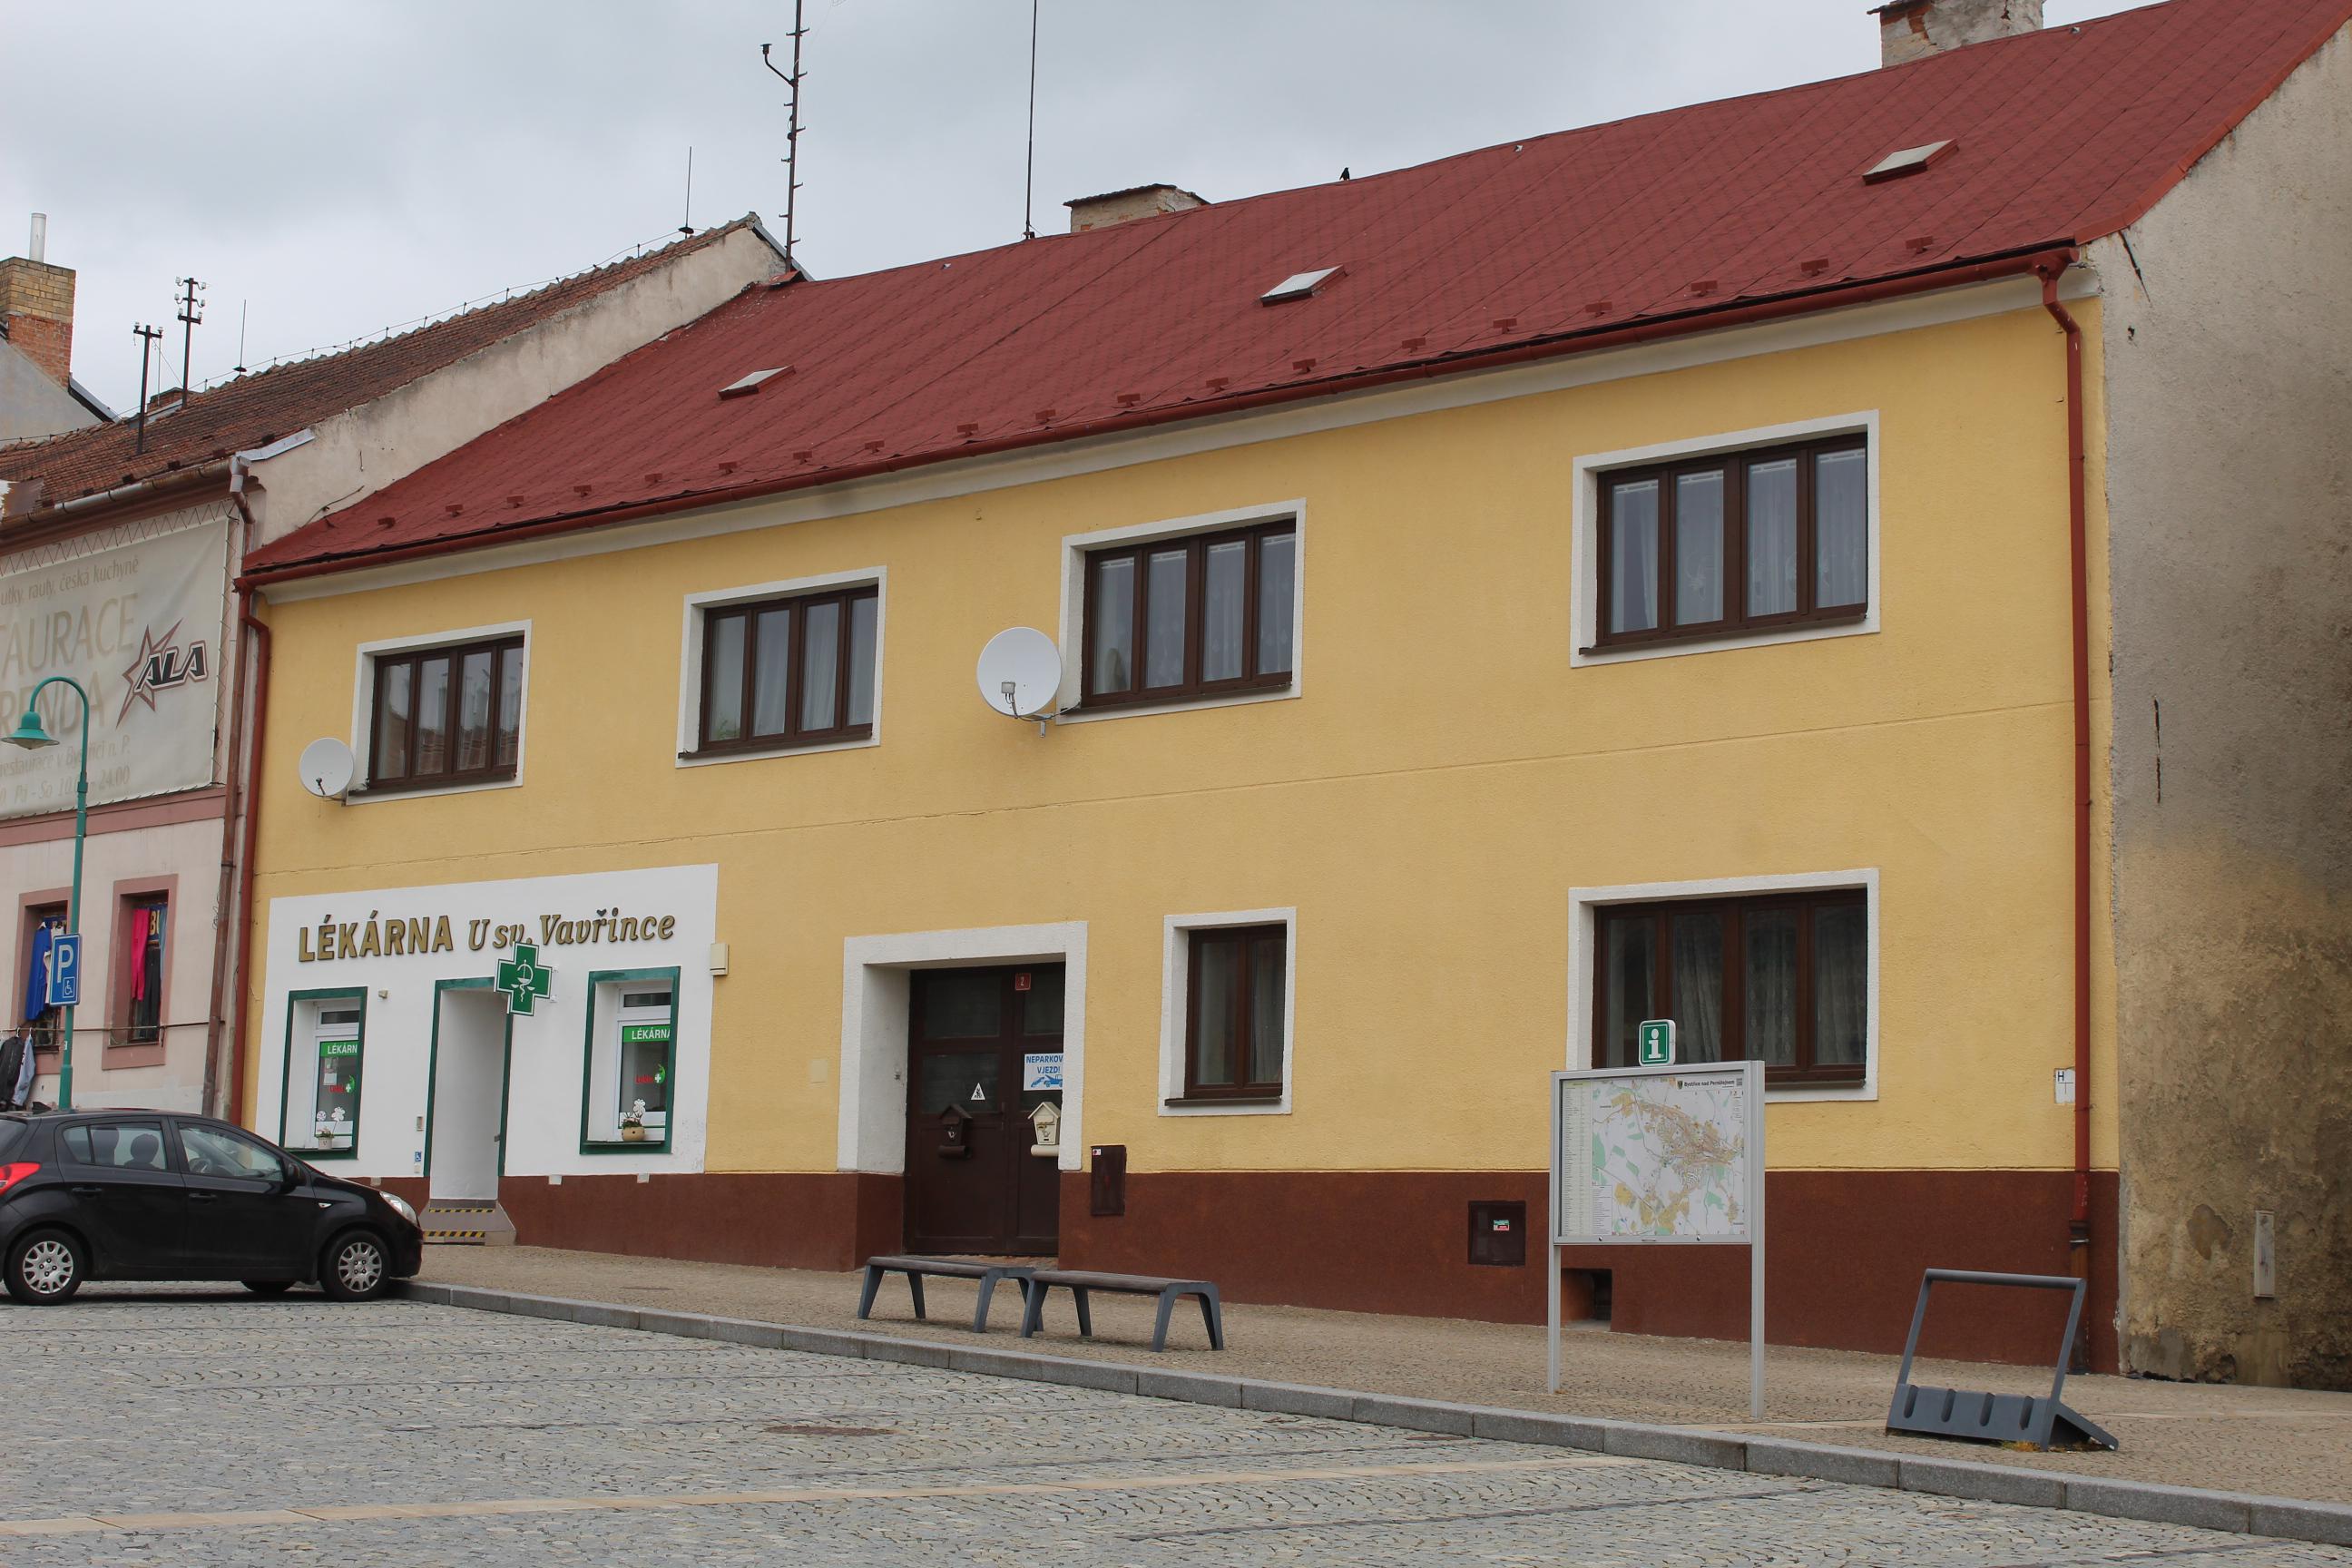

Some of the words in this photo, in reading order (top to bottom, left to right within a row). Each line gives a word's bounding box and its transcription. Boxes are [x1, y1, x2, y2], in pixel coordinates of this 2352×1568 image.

[60, 567, 90, 592] česká
[93, 554, 139, 582] kuchyně
[0, 593, 138, 677] AURACE
[133, 640, 208, 693] ALA
[298, 909, 454, 963] LÉKÁRNA
[468, 918, 491, 951] U
[492, 923, 533, 949] sv.
[540, 907, 676, 946] Vavřince
[57, 944, 74, 984] P
[328, 1043, 358, 1054] LÉKÁRN
[1036, 1065, 1061, 1074] VJEZD!
[2057, 1070, 2064, 1082] H
